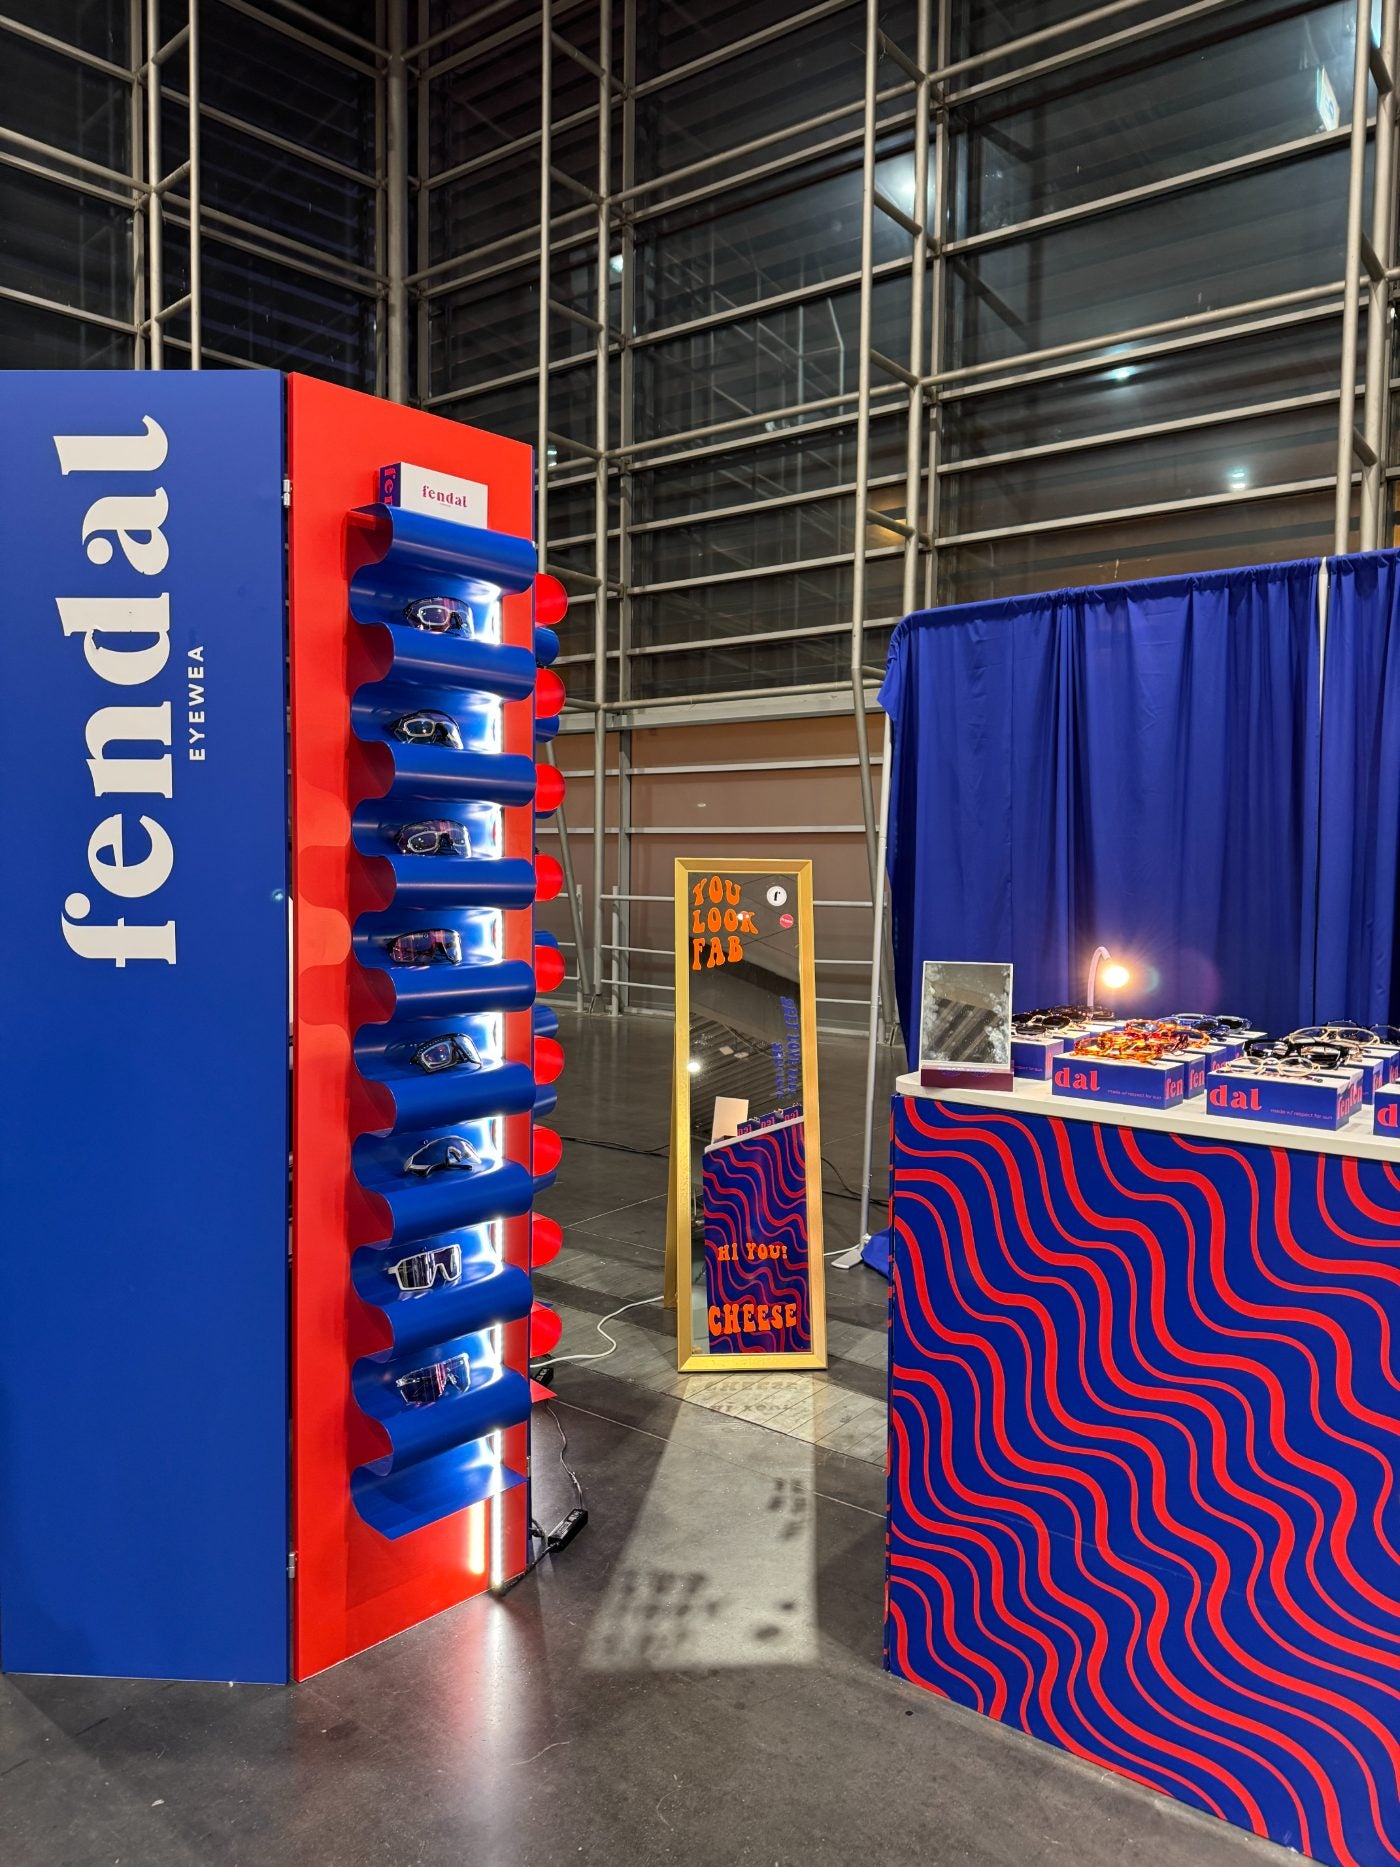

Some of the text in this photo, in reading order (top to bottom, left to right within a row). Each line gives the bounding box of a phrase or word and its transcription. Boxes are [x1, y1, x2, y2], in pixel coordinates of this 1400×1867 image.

[422, 484, 467, 508] fendal
[52, 414, 177, 968] fendal
[187, 645, 206, 761] EYEWEA
[692, 875, 741, 906] YOU
[692, 907, 759, 935] LOOK
[692, 935, 743, 970] FAB
[1054, 1067, 1101, 1092] dal
[1166, 1078, 1183, 1100] fen
[1189, 1069, 1205, 1090] fen
[1209, 1085, 1262, 1111] dal
[718, 1242, 788, 1261] HI YOU!
[708, 1303, 797, 1336] CHEESE
